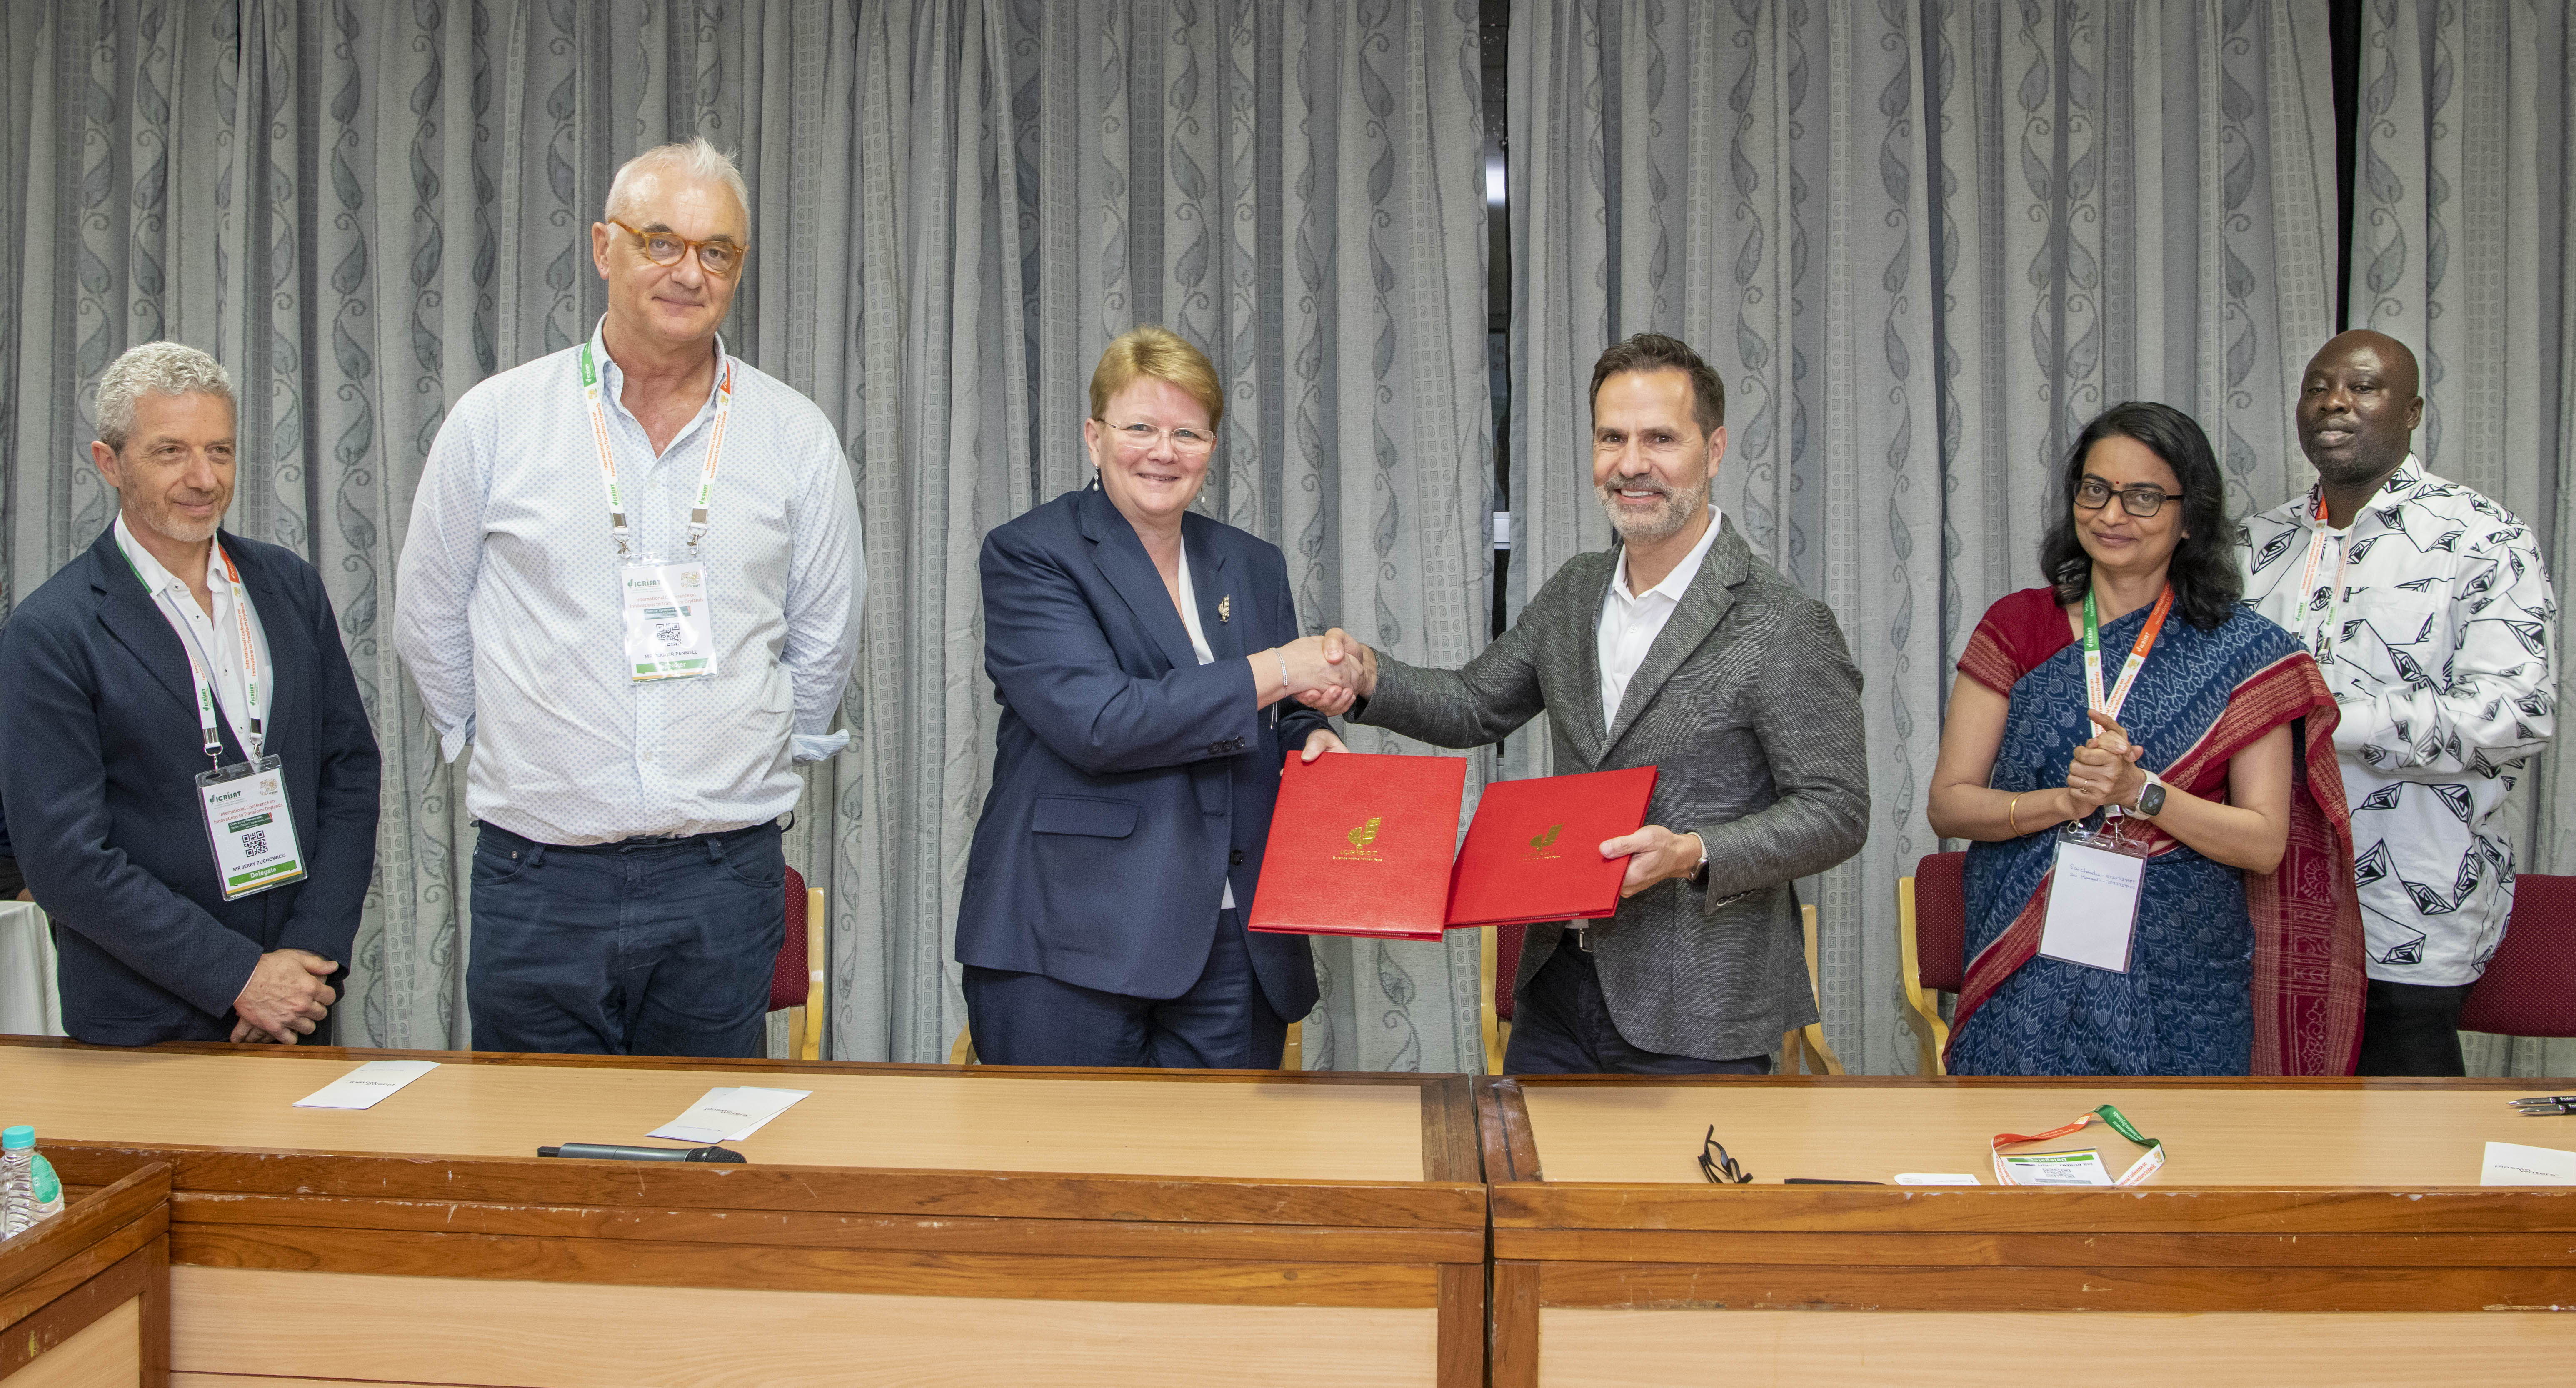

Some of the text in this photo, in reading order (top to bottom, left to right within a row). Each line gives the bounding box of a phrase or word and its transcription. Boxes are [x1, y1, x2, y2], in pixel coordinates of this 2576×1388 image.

[594, 417, 602, 442] Conference
[598, 442, 608, 470] International
[705, 444, 715, 471] International
[712, 419, 720, 443] Conference
[607, 450, 616, 477] Innovations
[710, 454, 718, 479] Innovations
[2109, 685, 2121, 708] Conference
[2112, 692, 2124, 714] Transform
[2121, 674, 2133, 692] Drylands
[216, 791, 241, 802] ICRISAT
[214, 814, 238, 824] Innovations
[219, 806, 246, 816] International
[247, 801, 270, 809] Conference
[257, 853, 286, 865] ZUCHOWICKI
[250, 867, 277, 878] Delegate
[2113, 1111, 2127, 1126] Drylands
